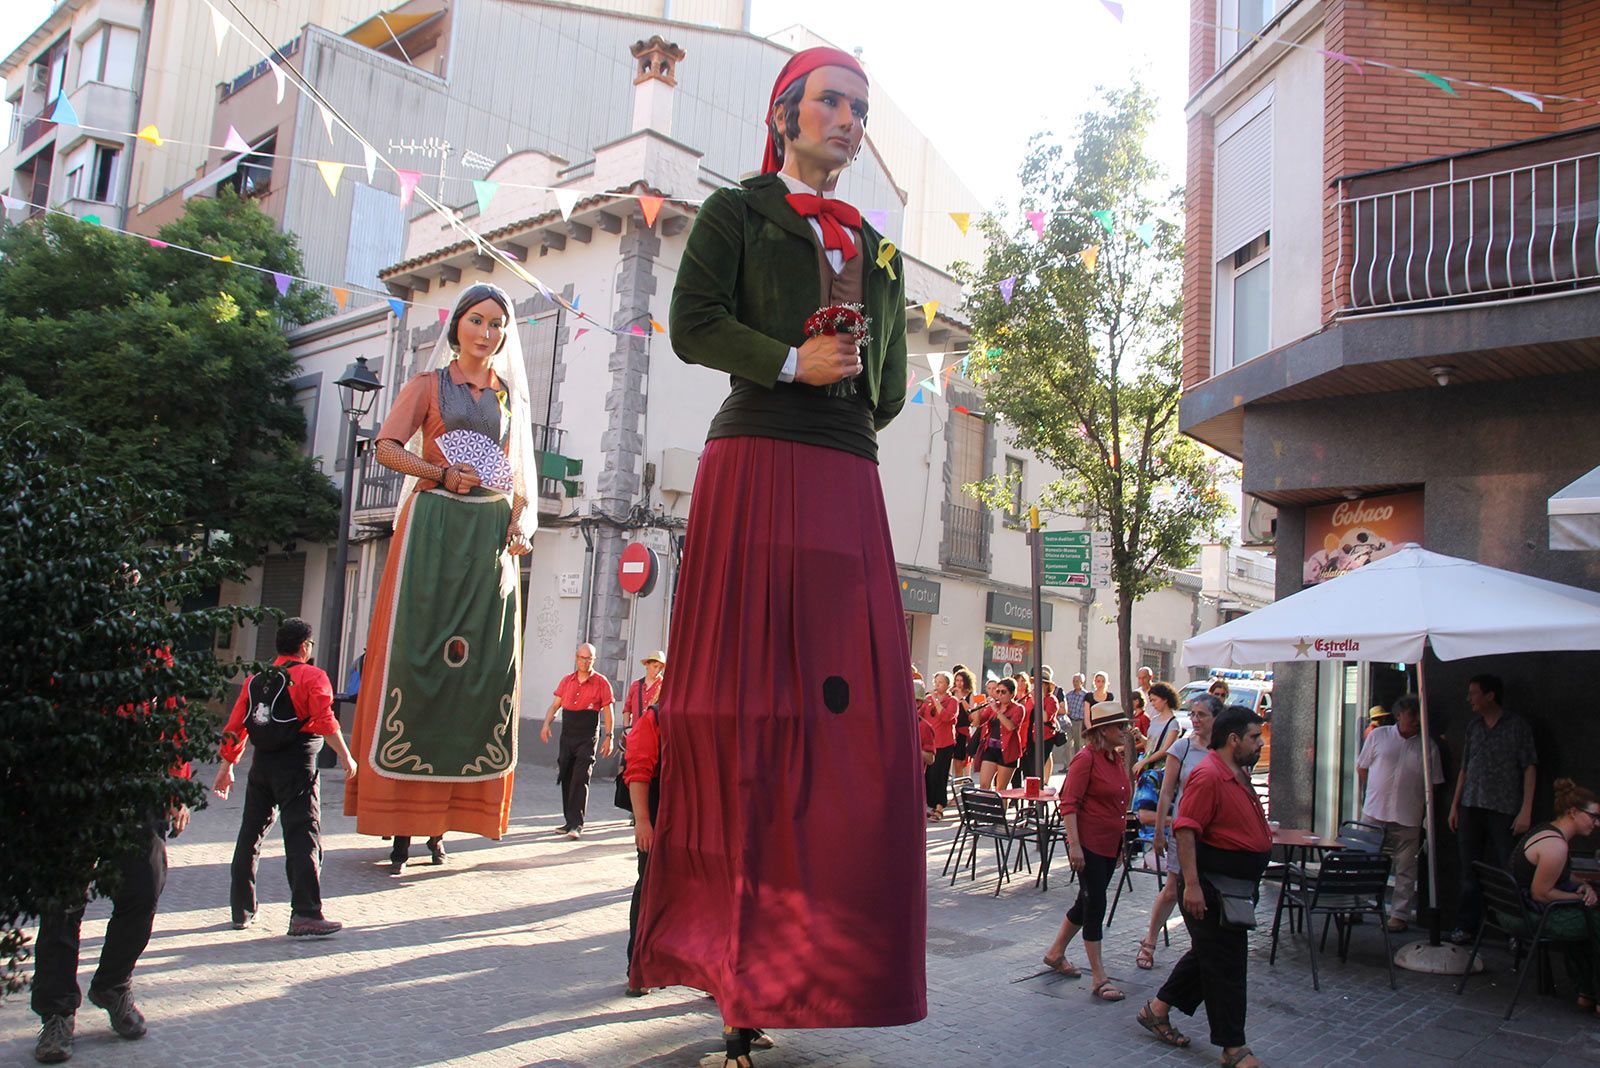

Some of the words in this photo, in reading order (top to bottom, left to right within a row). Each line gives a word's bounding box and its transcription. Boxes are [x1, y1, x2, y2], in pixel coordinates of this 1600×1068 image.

[1331, 501, 1394, 527] Cobaco
[909, 588, 937, 603] natur
[1314, 638, 1360, 652] Estrella
[992, 645, 1024, 662] REBAIXES
